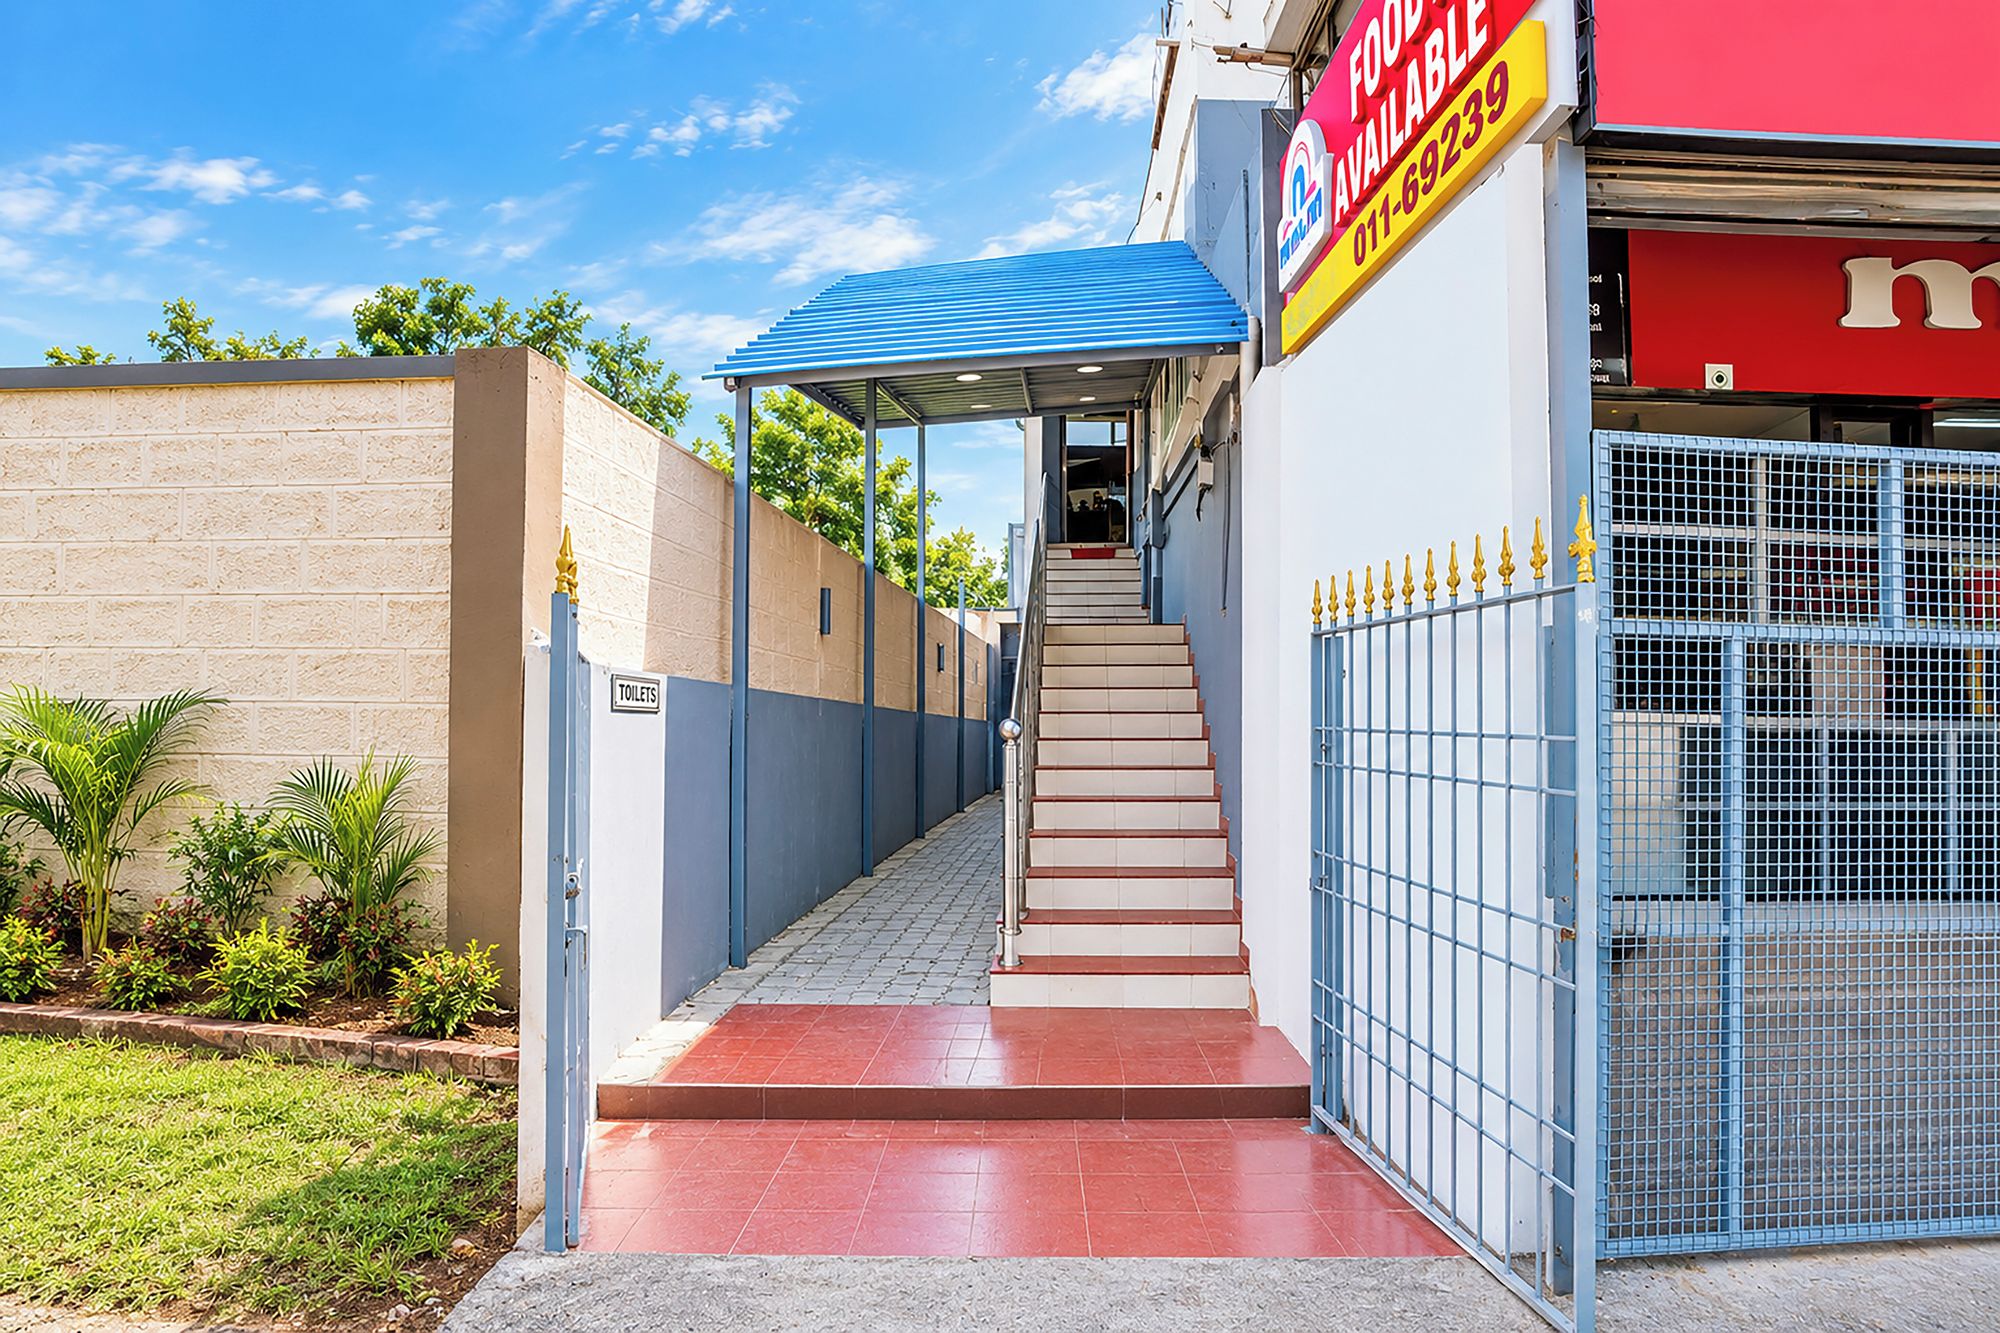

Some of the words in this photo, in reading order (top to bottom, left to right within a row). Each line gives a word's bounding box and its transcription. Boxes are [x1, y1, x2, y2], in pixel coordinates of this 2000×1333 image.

[1334, 0, 1488, 227] AVAILABLE
[1354, 60, 1509, 267] 011-69239
[618, 683, 657, 703] TOILETS
